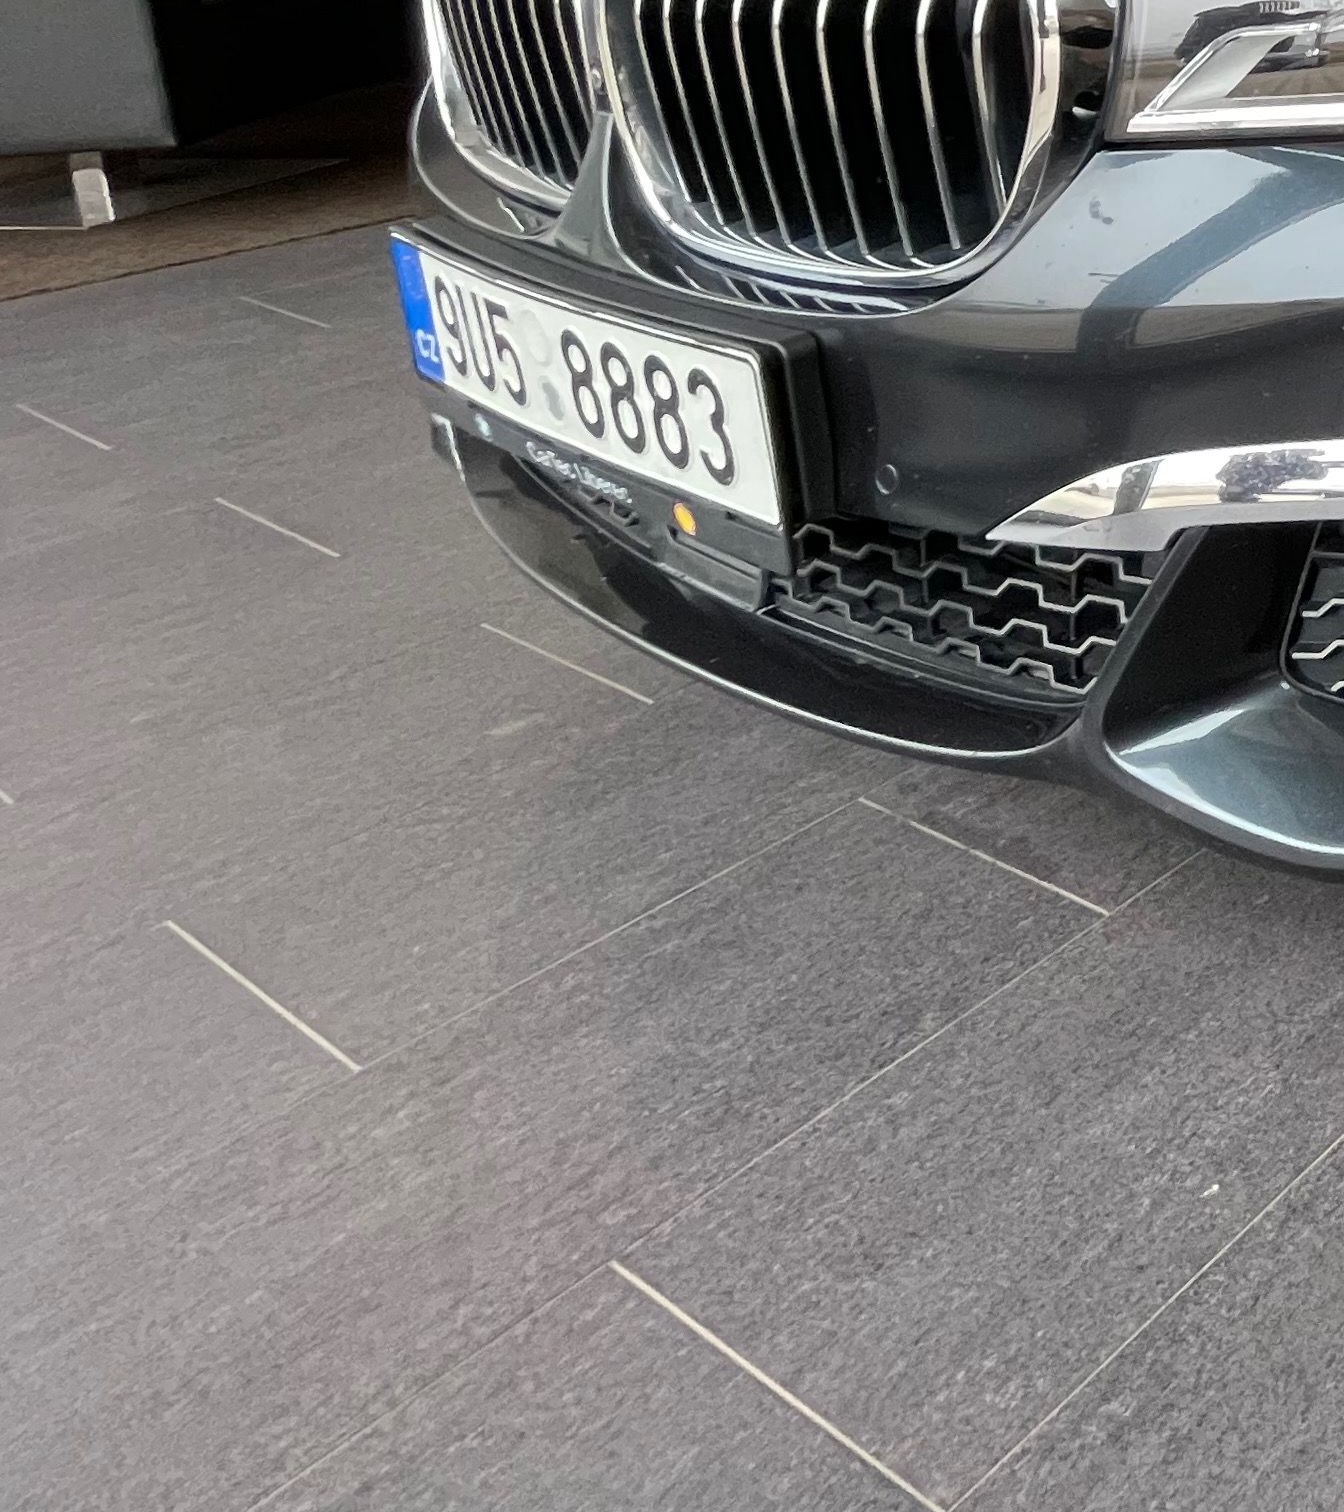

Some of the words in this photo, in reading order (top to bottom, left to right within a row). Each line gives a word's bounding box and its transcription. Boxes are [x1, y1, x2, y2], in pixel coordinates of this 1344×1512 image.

[416, 328, 440, 363] CZ
[434, 274, 527, 407] 9U5
[560, 328, 736, 487] 8883
